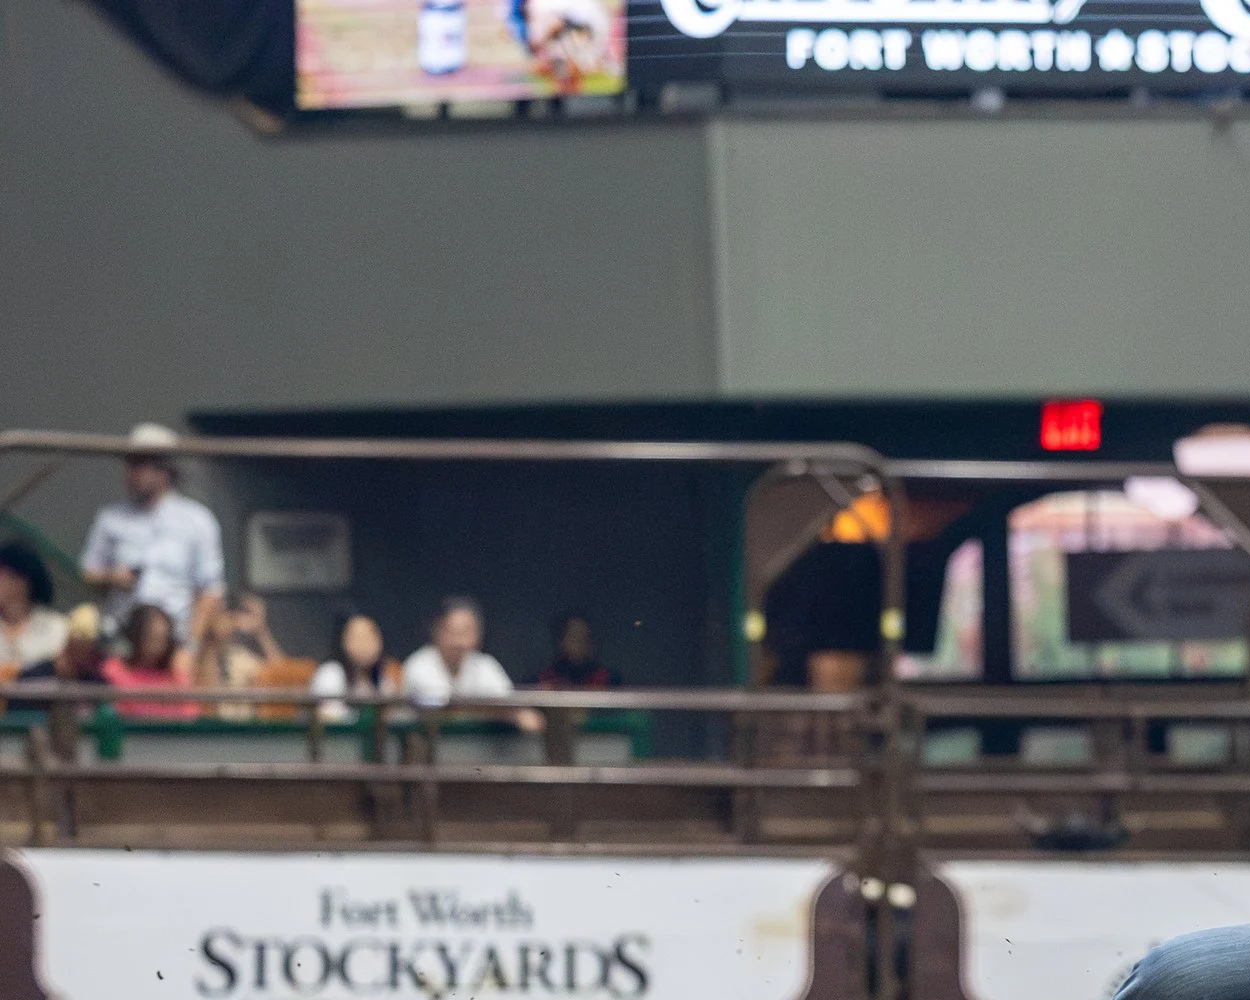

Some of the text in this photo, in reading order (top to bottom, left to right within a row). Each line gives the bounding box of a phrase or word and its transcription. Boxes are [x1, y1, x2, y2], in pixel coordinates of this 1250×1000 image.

[786, 29, 911, 70] FORT
[922, 29, 1092, 72] WORTH
[319, 886, 535, 929] Fort Worth
[196, 927, 653, 1000] STOCKYARDS
